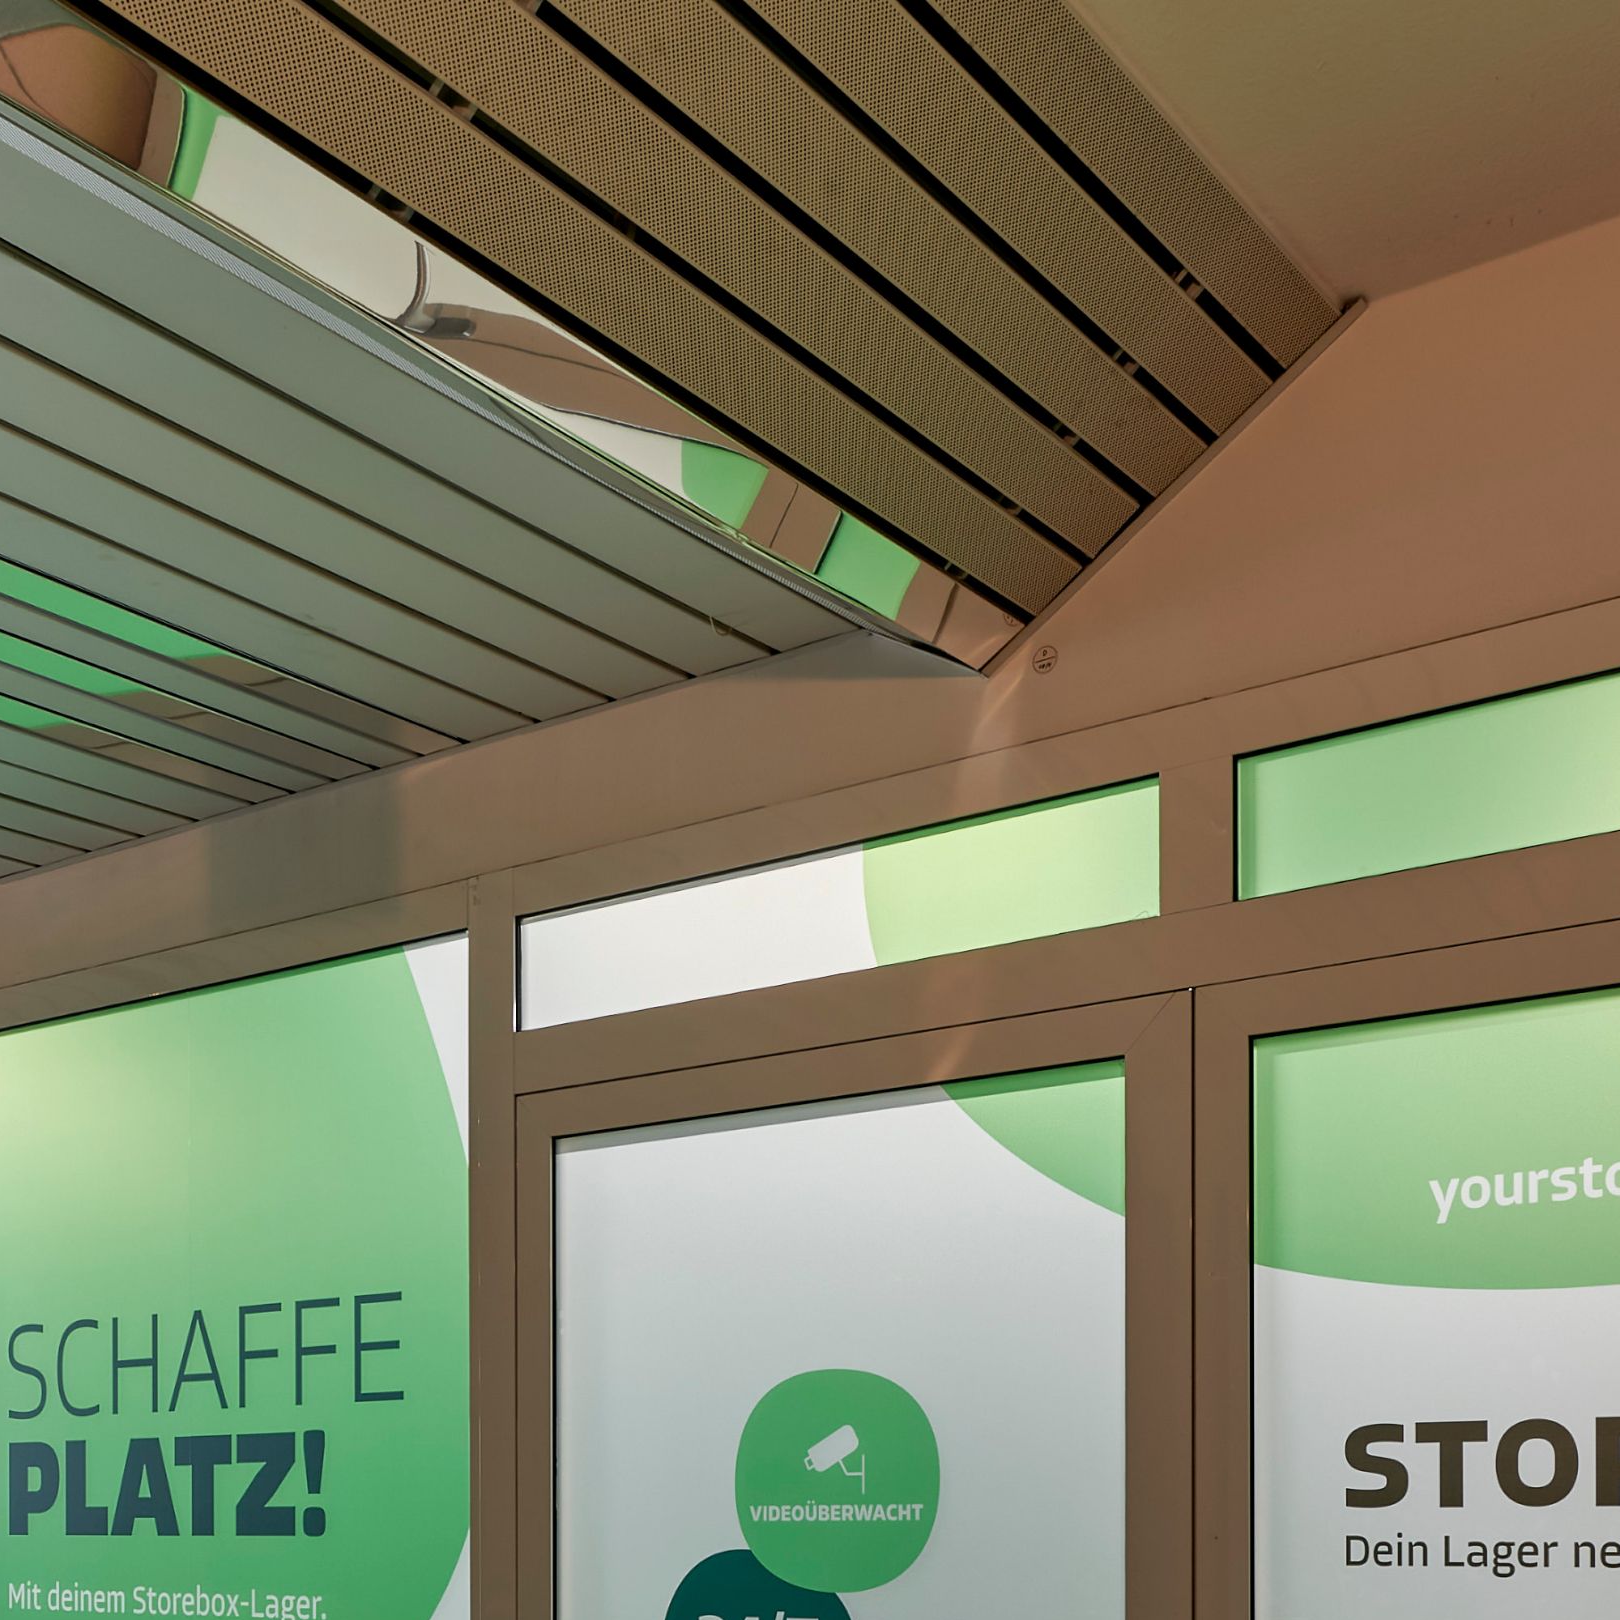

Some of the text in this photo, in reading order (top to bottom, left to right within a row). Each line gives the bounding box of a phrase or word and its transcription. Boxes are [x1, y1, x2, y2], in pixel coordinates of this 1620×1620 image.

[9, 1291, 404, 1419] SCHAFFE
[9, 1430, 326, 1537] PLATZ!
[750, 1501, 923, 1521] VIDEOÜBERWACHT
[1346, 1533, 1427, 1566] Dein
[1443, 1535, 1558, 1578] Lager
[9, 1581, 41, 1610] Mit
[48, 1582, 124, 1613] deinem
